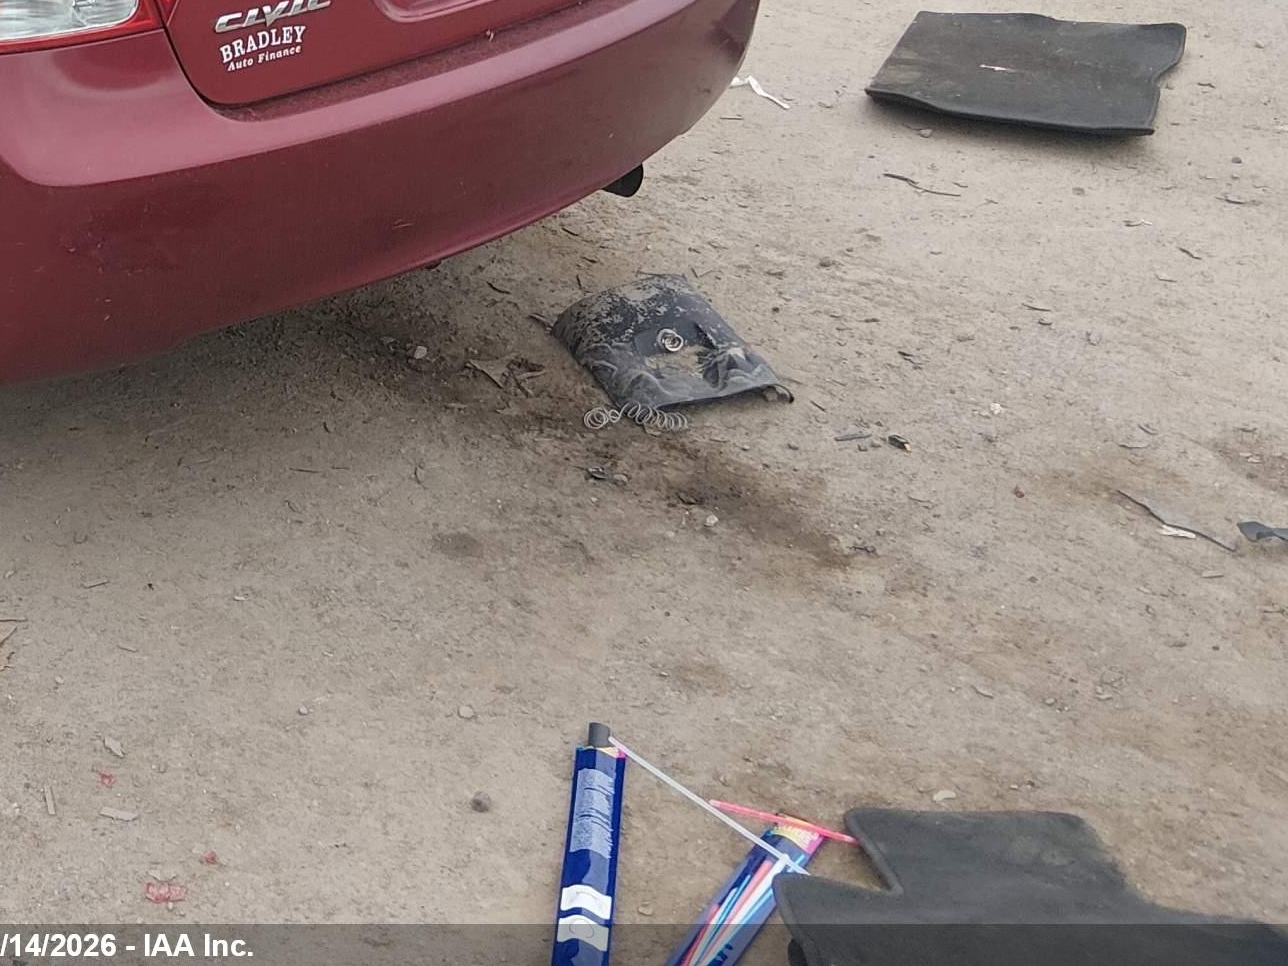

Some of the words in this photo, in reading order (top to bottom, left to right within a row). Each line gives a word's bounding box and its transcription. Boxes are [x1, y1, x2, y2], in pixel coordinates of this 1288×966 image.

[219, 25, 306, 63] BRADLEY
[227, 57, 254, 72] Auto
[257, 45, 302, 64] Finance
